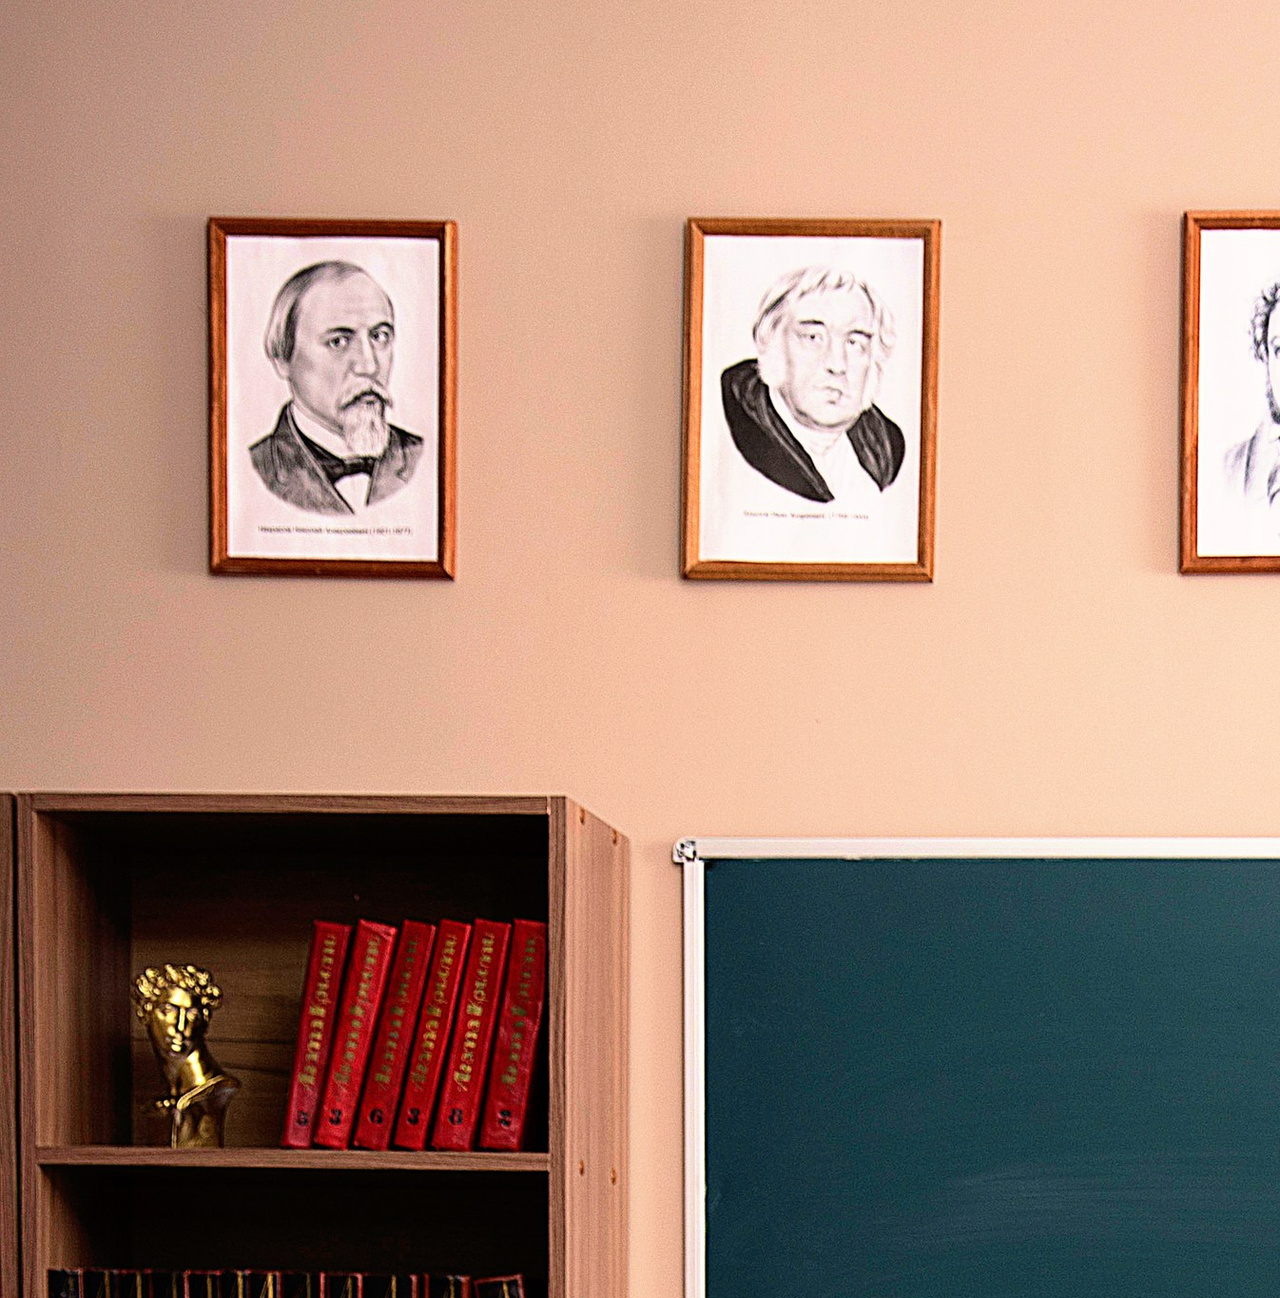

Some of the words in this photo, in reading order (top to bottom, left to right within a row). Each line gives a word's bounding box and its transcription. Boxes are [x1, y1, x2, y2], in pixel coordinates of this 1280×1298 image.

[329, 1108, 343, 1126] 3
[369, 1108, 383, 1125] 6
[407, 1108, 420, 1125] 3
